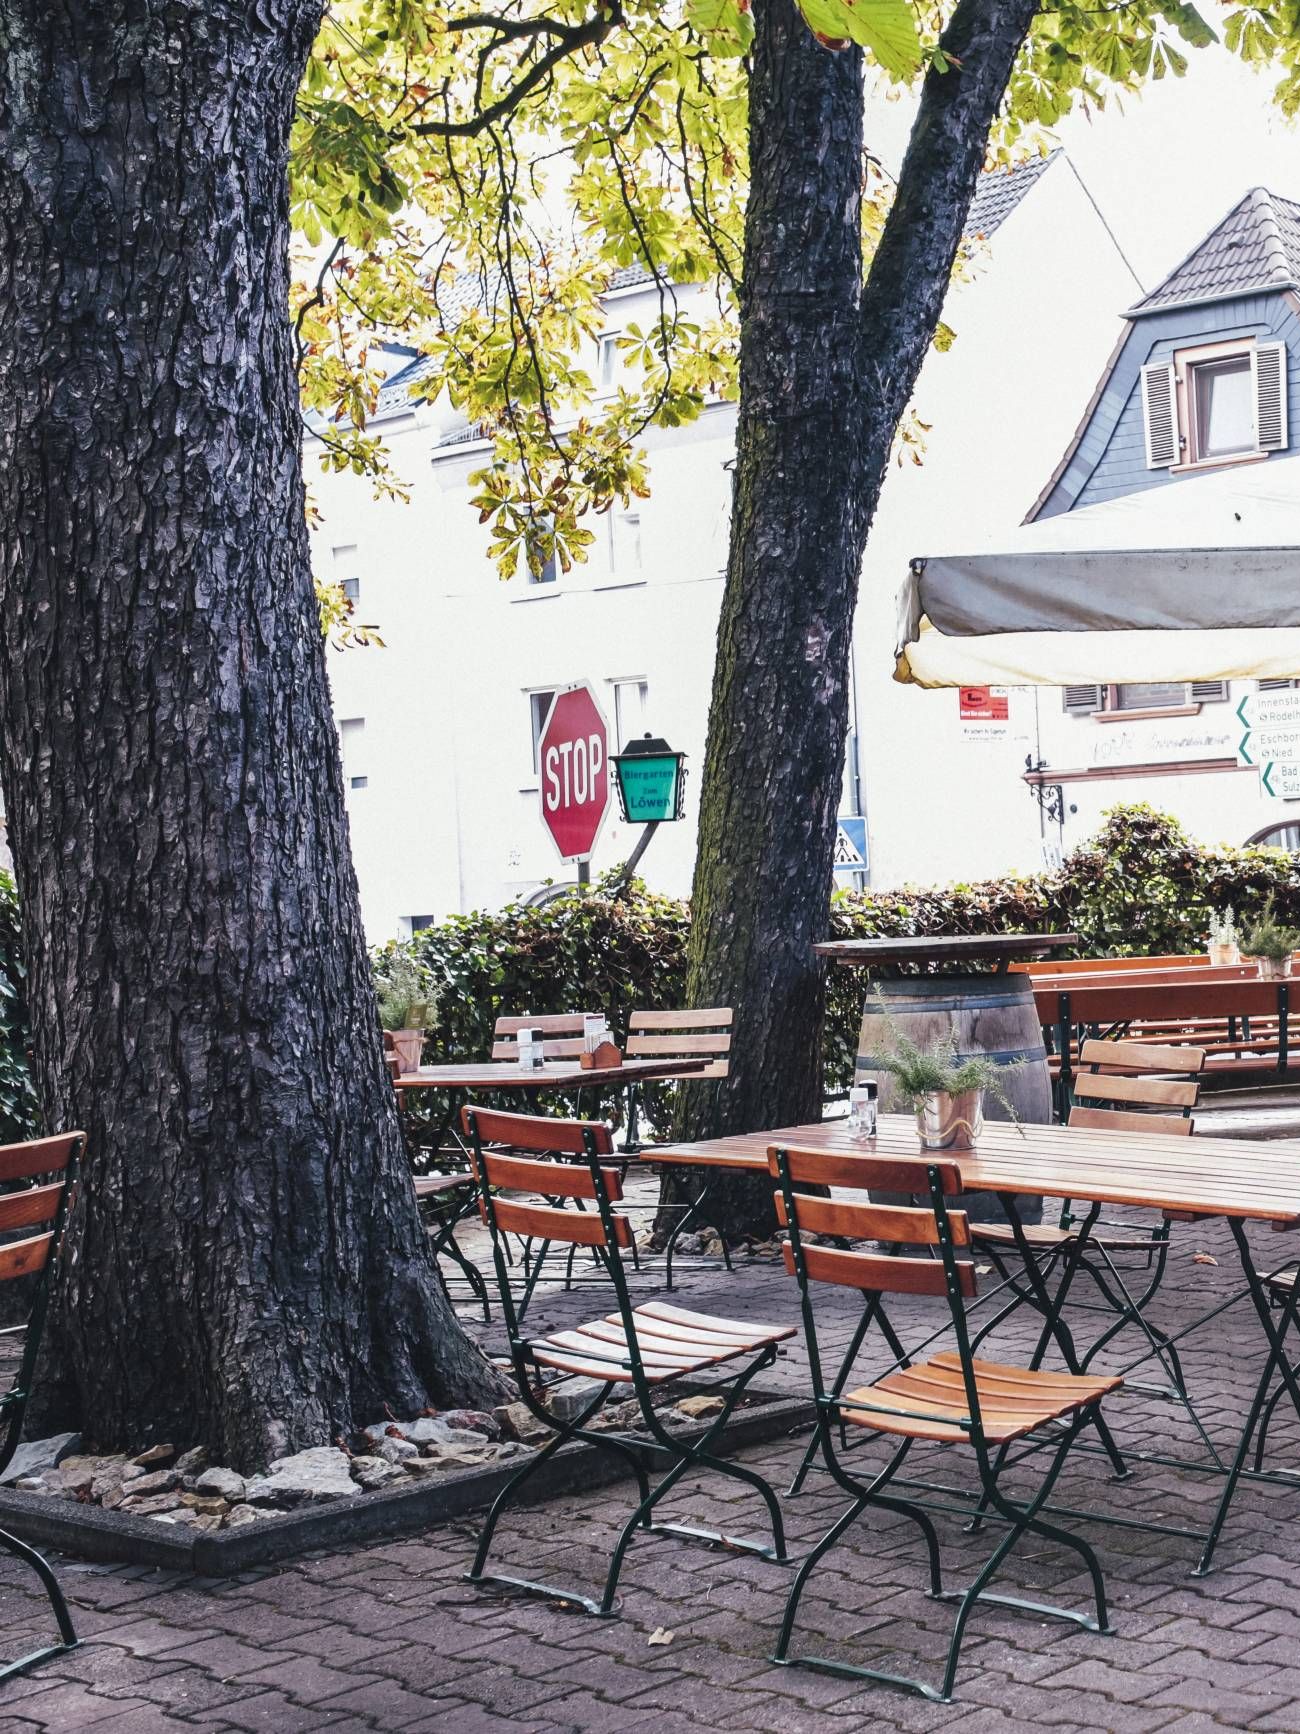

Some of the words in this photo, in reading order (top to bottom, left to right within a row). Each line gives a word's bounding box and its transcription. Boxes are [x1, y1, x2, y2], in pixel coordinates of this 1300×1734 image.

[1272, 748, 1293, 757] Nied
[546, 734, 603, 812] STOP
[624, 770, 673, 780] Biergarten
[1281, 766, 1298, 776] Bad
[631, 795, 671, 809] Löwen
